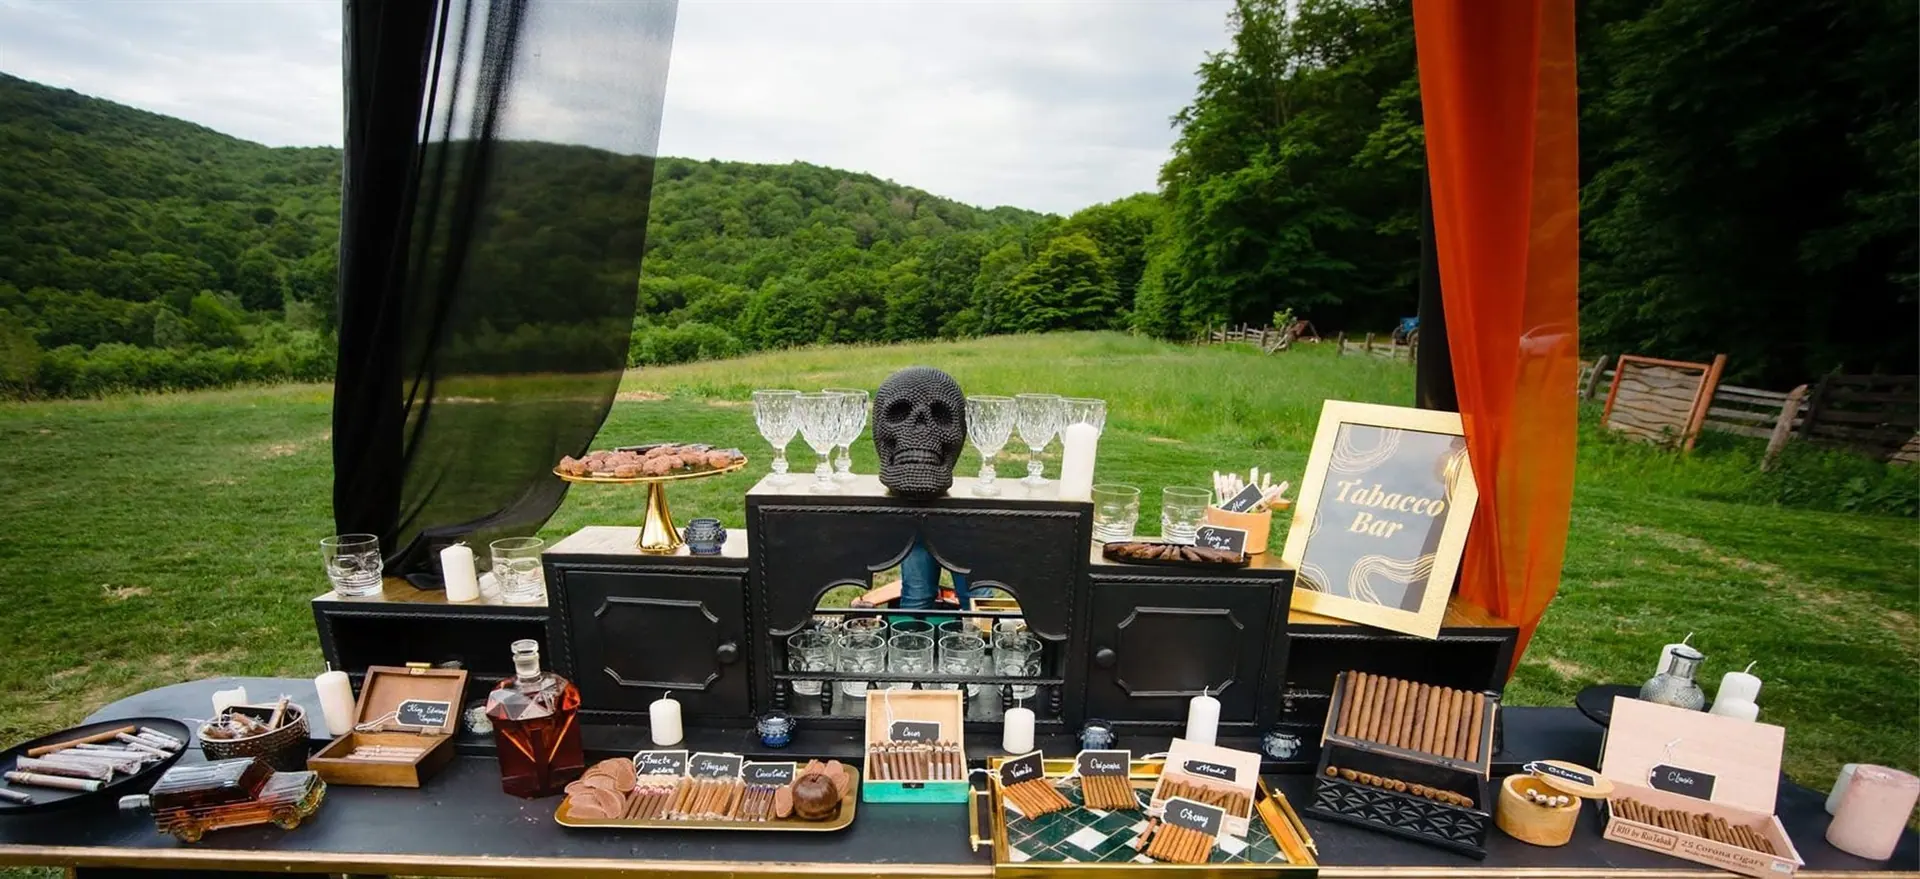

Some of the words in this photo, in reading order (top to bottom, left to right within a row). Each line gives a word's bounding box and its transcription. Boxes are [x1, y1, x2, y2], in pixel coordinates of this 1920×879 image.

[1336, 479, 1445, 517] Tabacco
[1346, 511, 1404, 539] Bar
[1180, 808, 1209, 828] Cherry
[1631, 828, 1640, 838] by
[1681, 839, 1695, 849] 25
[1695, 843, 1731, 858] Corona
[1733, 853, 1765, 867] Cigars
